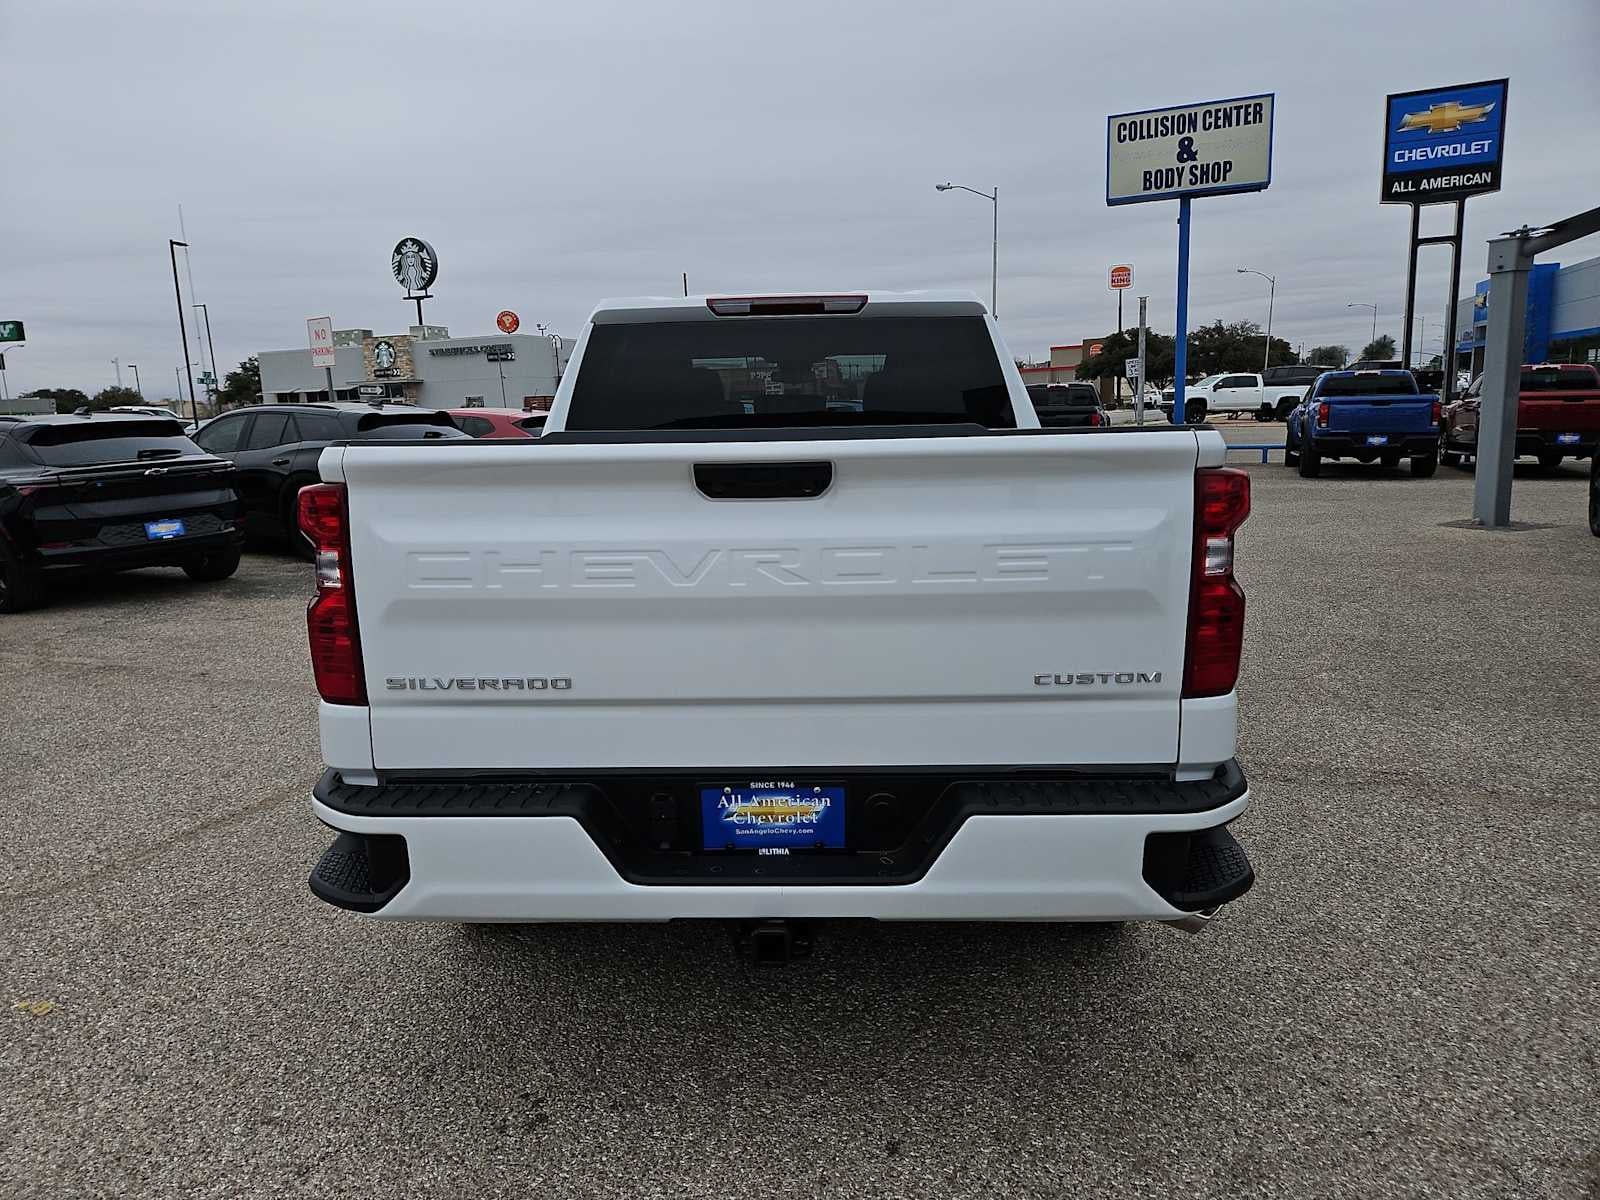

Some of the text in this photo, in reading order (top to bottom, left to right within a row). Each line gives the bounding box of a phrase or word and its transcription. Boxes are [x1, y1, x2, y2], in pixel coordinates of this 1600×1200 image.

[1117, 103, 1264, 143] COLLISION CENTER
[1176, 137, 1198, 163] &
[1394, 140, 1492, 163] CHEVROLET
[1142, 161, 1233, 191] BODY SHOP
[1391, 172, 1491, 193] ALL AMERICAN
[314, 328, 327, 340] NO
[407, 541, 1134, 589] CHEVROLET
[385, 677, 572, 690] SILVERADO
[1034, 672, 1162, 686] CUSTOM
[717, 795, 831, 808] All American
[733, 811, 818, 825] Chevrolet
